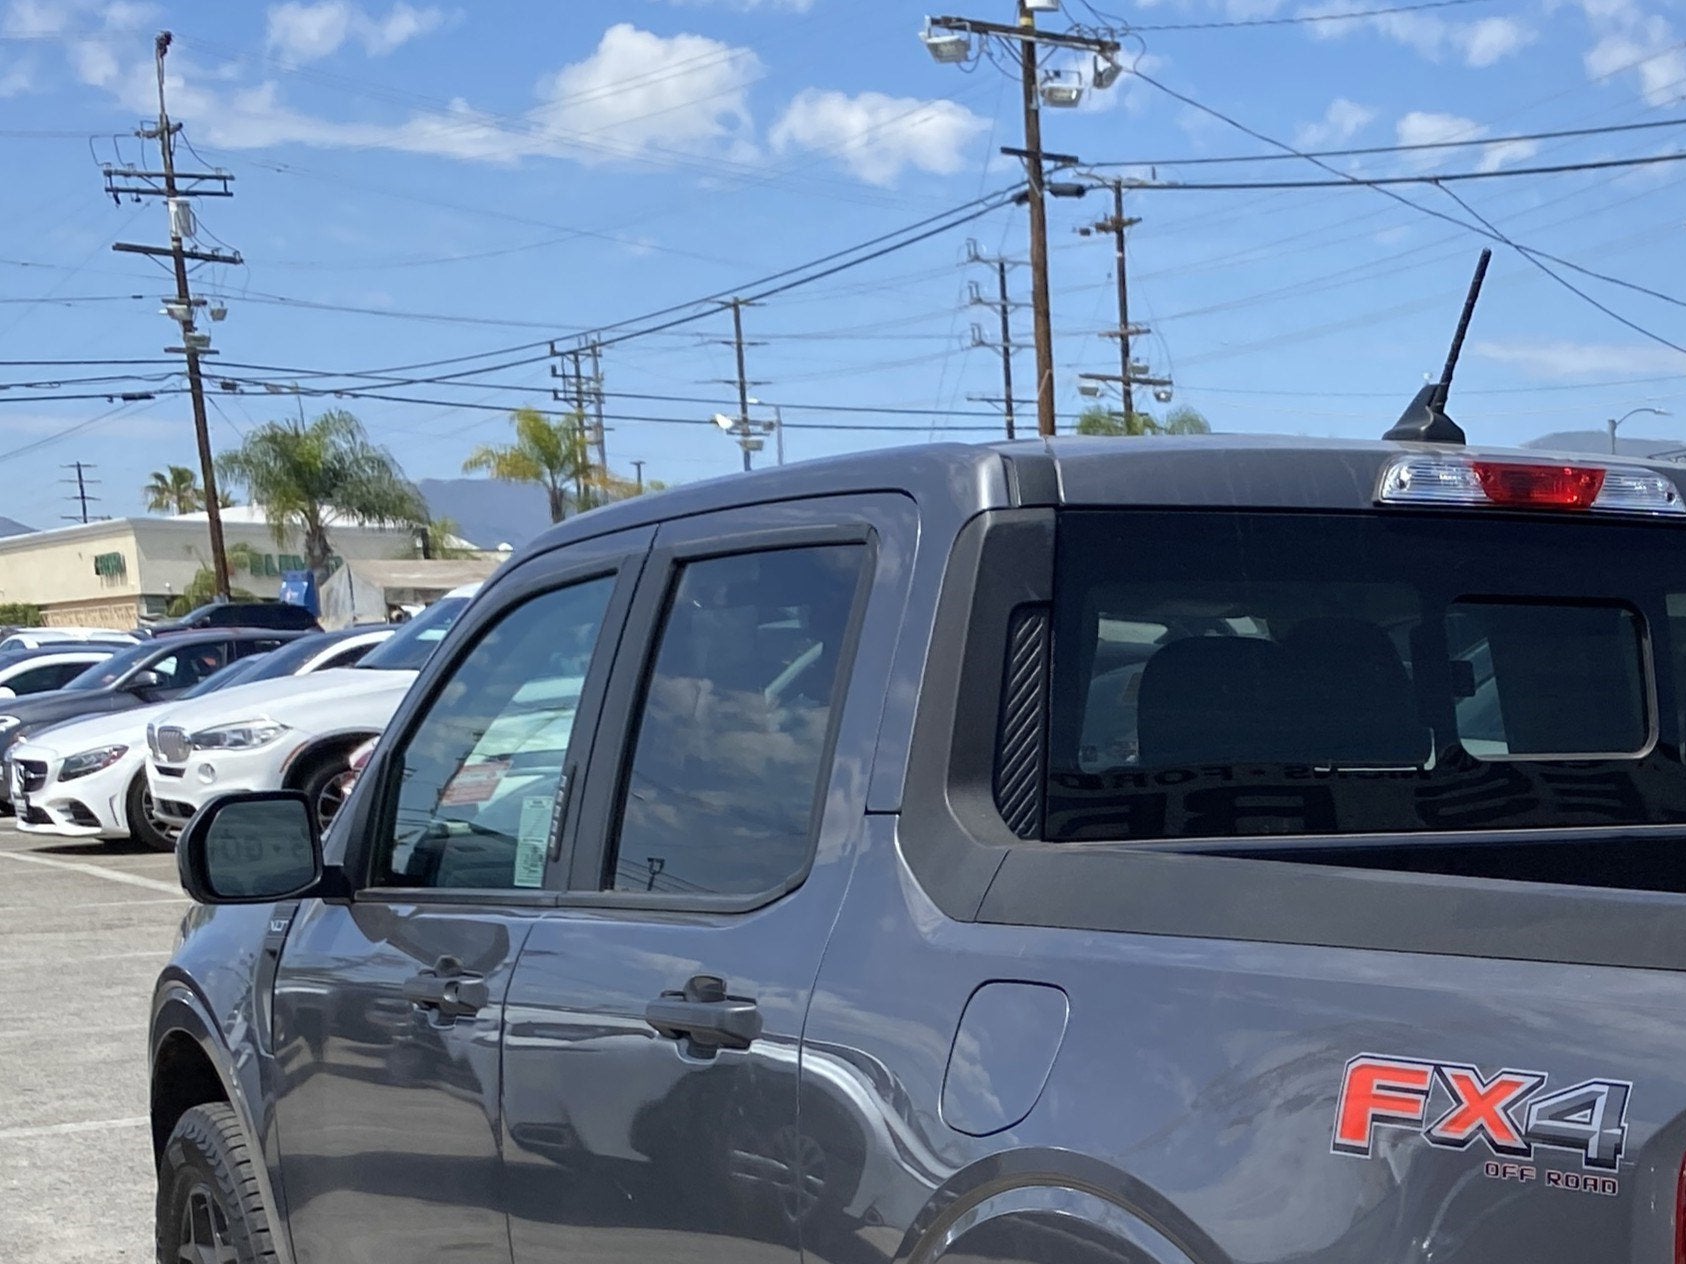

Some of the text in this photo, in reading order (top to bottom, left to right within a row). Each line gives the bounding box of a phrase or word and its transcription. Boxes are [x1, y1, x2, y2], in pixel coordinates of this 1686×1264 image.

[1330, 1051, 1633, 1173] FX4
[1484, 1160, 1619, 1196] OFF ROAD
